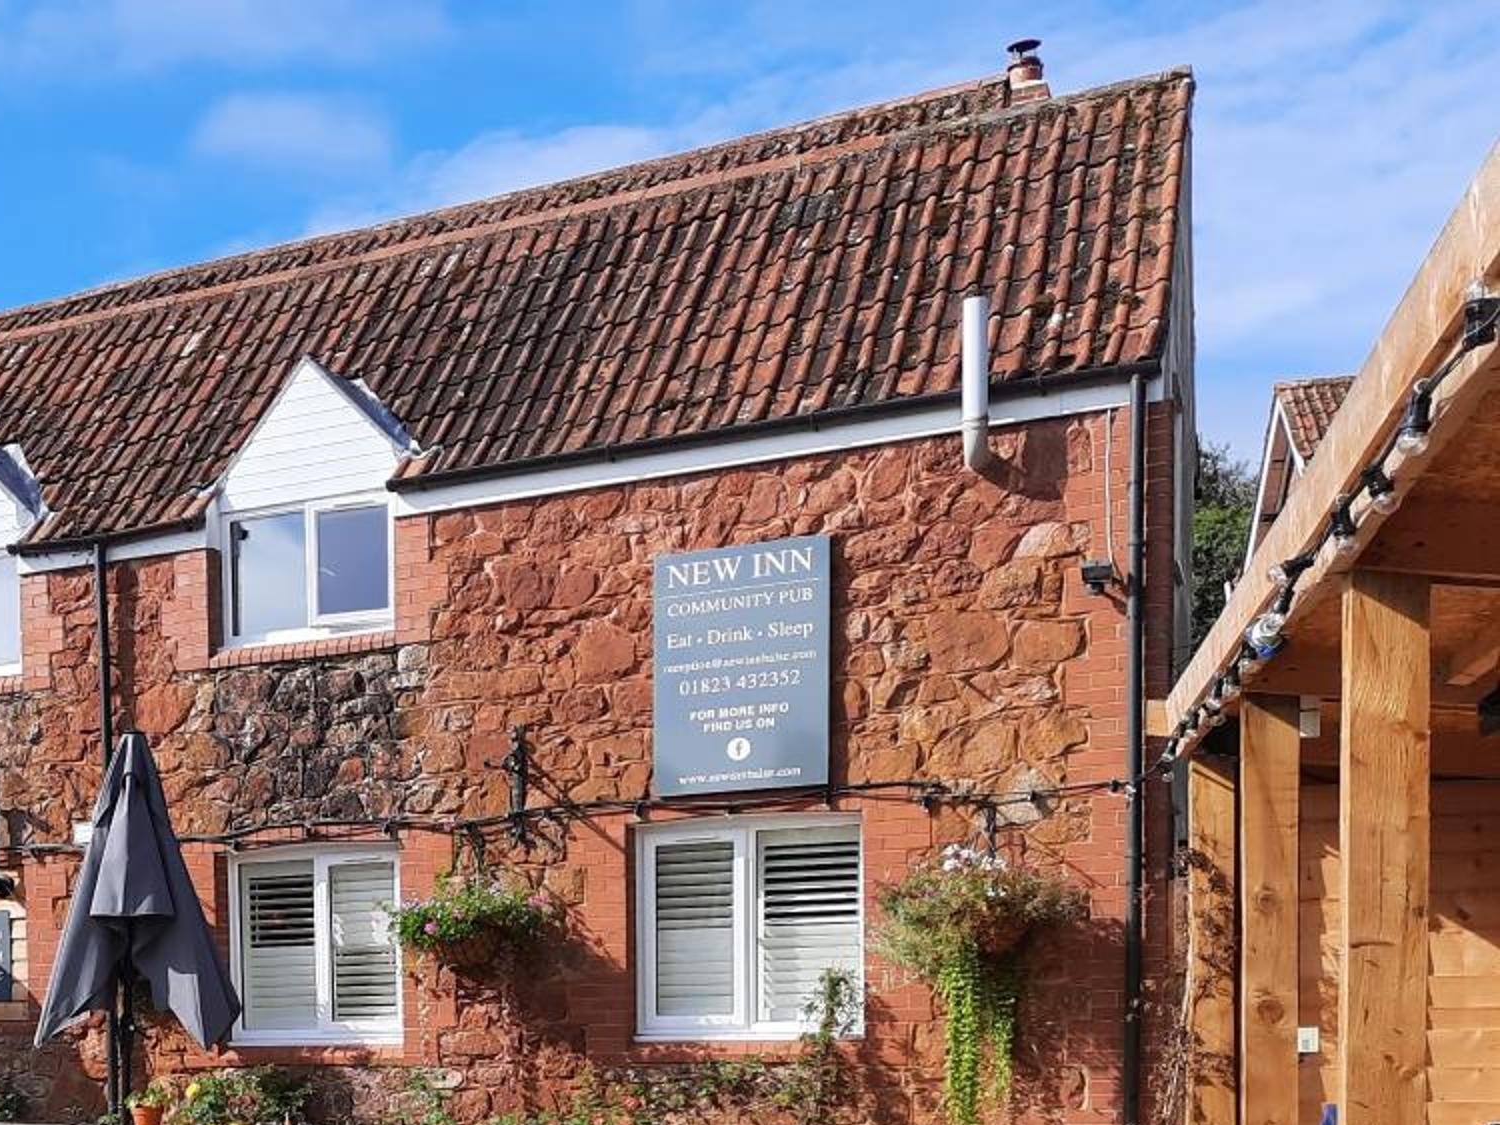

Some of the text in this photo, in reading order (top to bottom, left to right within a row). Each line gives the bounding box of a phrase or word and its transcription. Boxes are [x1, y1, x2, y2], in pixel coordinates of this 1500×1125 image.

[667, 547, 813, 588] NEW INN
[667, 587, 813, 617] COMMUNITY PUB
[667, 621, 813, 649] Eat Drink Sleep
[679, 669, 800, 696] 01823 432352
[688, 702, 789, 721] FOR MORE INFO
[703, 717, 775, 733] FIND US ON
